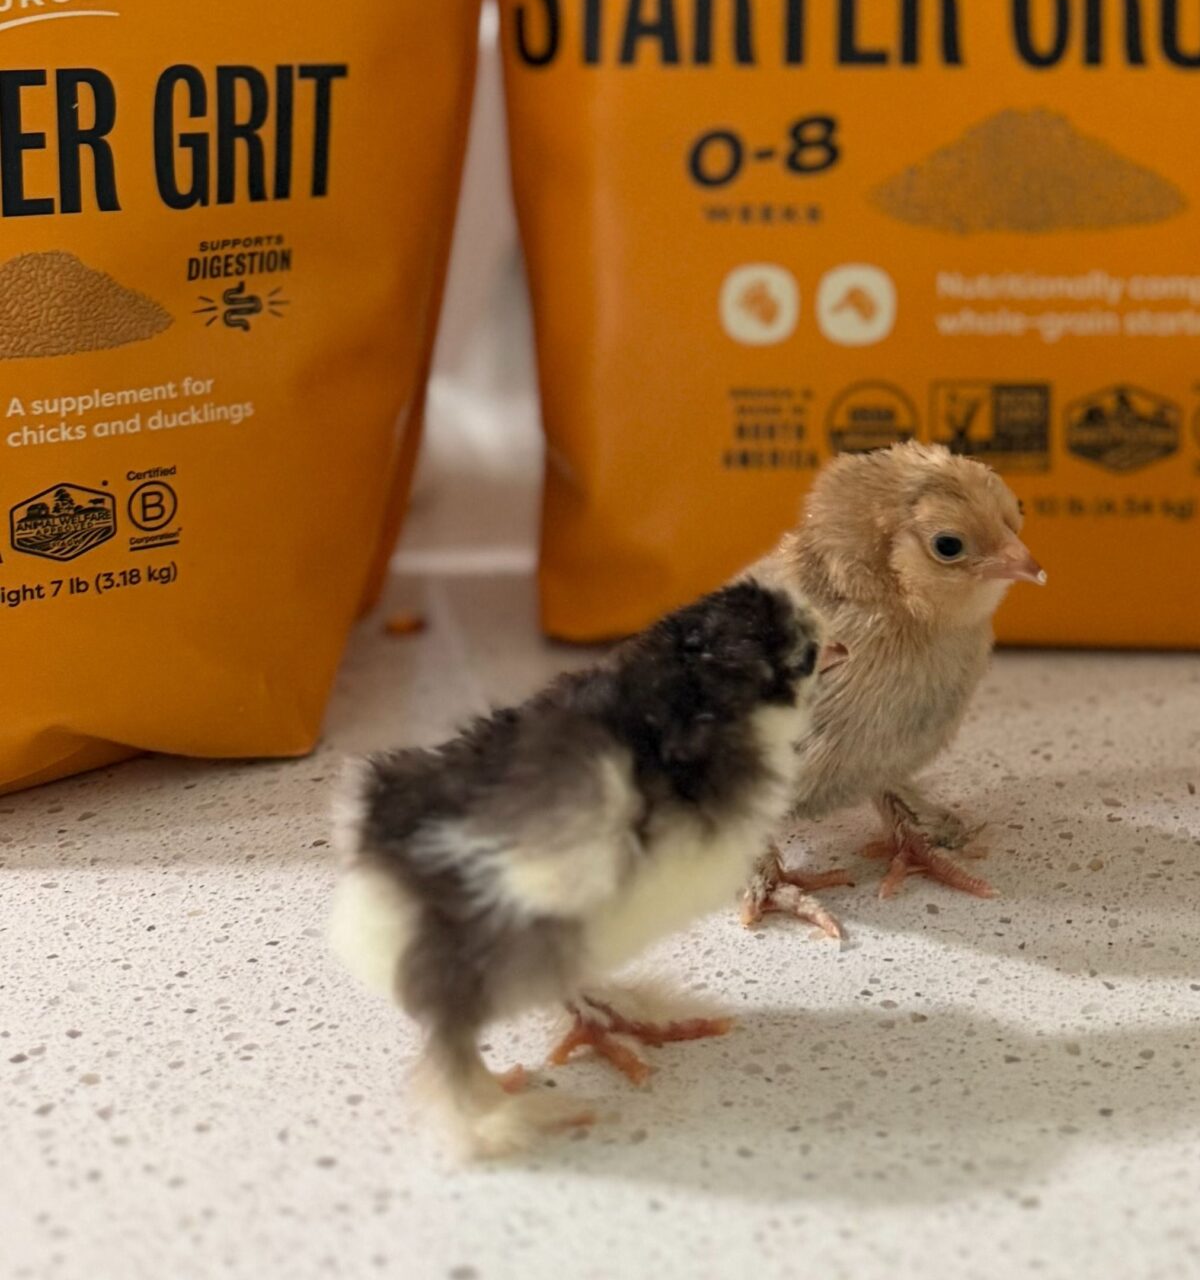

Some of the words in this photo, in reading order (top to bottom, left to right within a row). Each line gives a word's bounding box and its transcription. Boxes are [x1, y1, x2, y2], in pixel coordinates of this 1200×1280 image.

[0, 68, 121, 217] ER
[153, 63, 347, 210] GRIT
[686, 115, 843, 189] 0-8
[199, 234, 284, 252] SUPPORTS
[187, 248, 292, 281] DIGESTION
[6, 397, 25, 417] A
[32, 380, 177, 417] supplement
[182, 376, 215, 396] for
[7, 422, 87, 447] chicks
[93, 414, 141, 438] and
[148, 400, 254, 431] ducklings
[126, 465, 177, 481] Certified
[50, 580, 63, 596] 7
[70, 577, 89, 594] lb
[95, 569, 141, 594] (3.18
[148, 561, 177, 584] kg)
